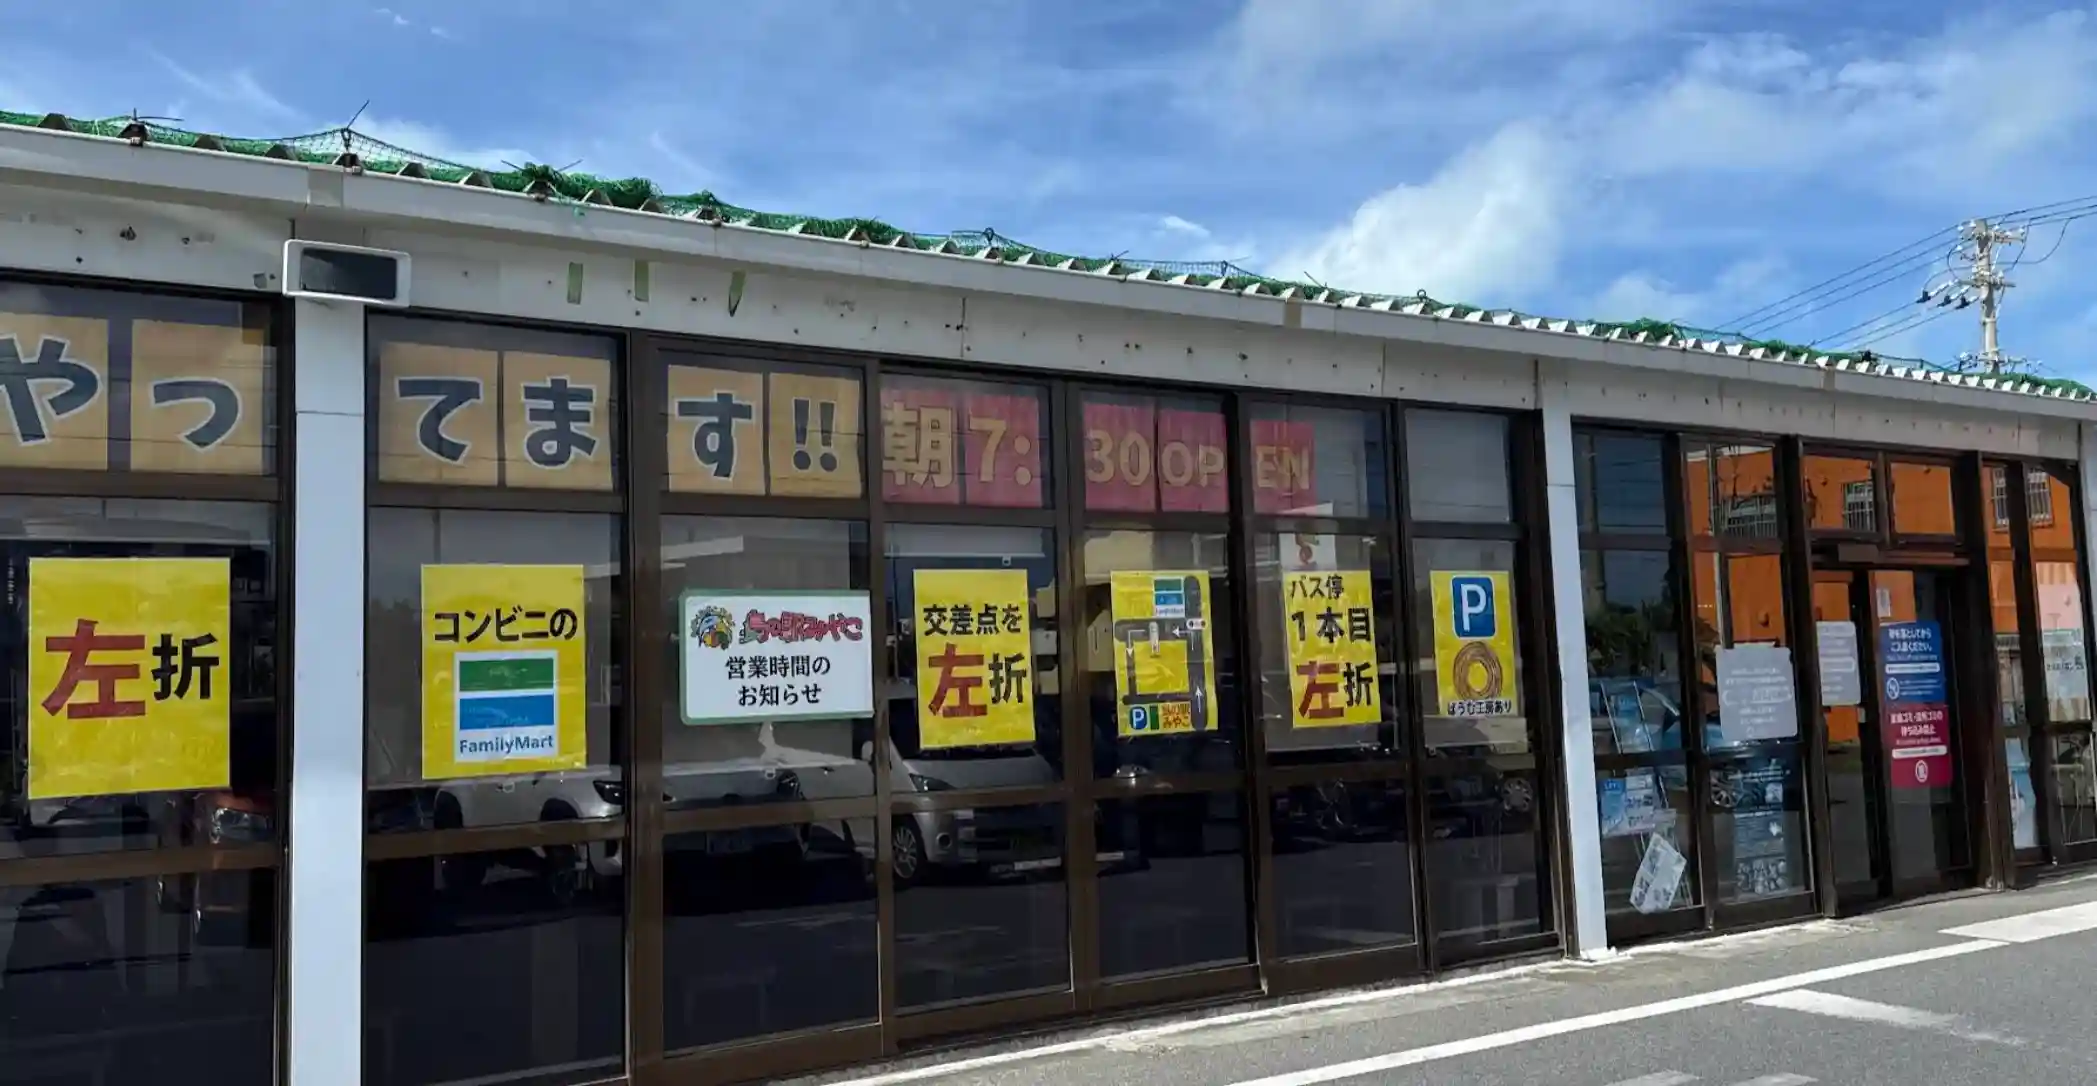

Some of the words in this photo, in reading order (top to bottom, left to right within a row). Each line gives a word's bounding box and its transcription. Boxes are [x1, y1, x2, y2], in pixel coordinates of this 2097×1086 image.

[1290, 574, 1344, 600] バス停
[923, 604, 1022, 637] 交差点を
[1460, 583, 1487, 632] P
[433, 606, 578, 643] コンビニの
[1291, 606, 1371, 643] 1本目
[42, 619, 220, 720] 左折
[725, 655, 831, 680] 営業時間の
[928, 643, 1027, 719] 左折
[738, 683, 822, 707] お知らせ
[1296, 661, 1374, 719] 左折
[1132, 708, 1145, 729] P
[1447, 701, 1512, 716] ばうむ工房あり
[459, 735, 555, 756] FamilyMart
